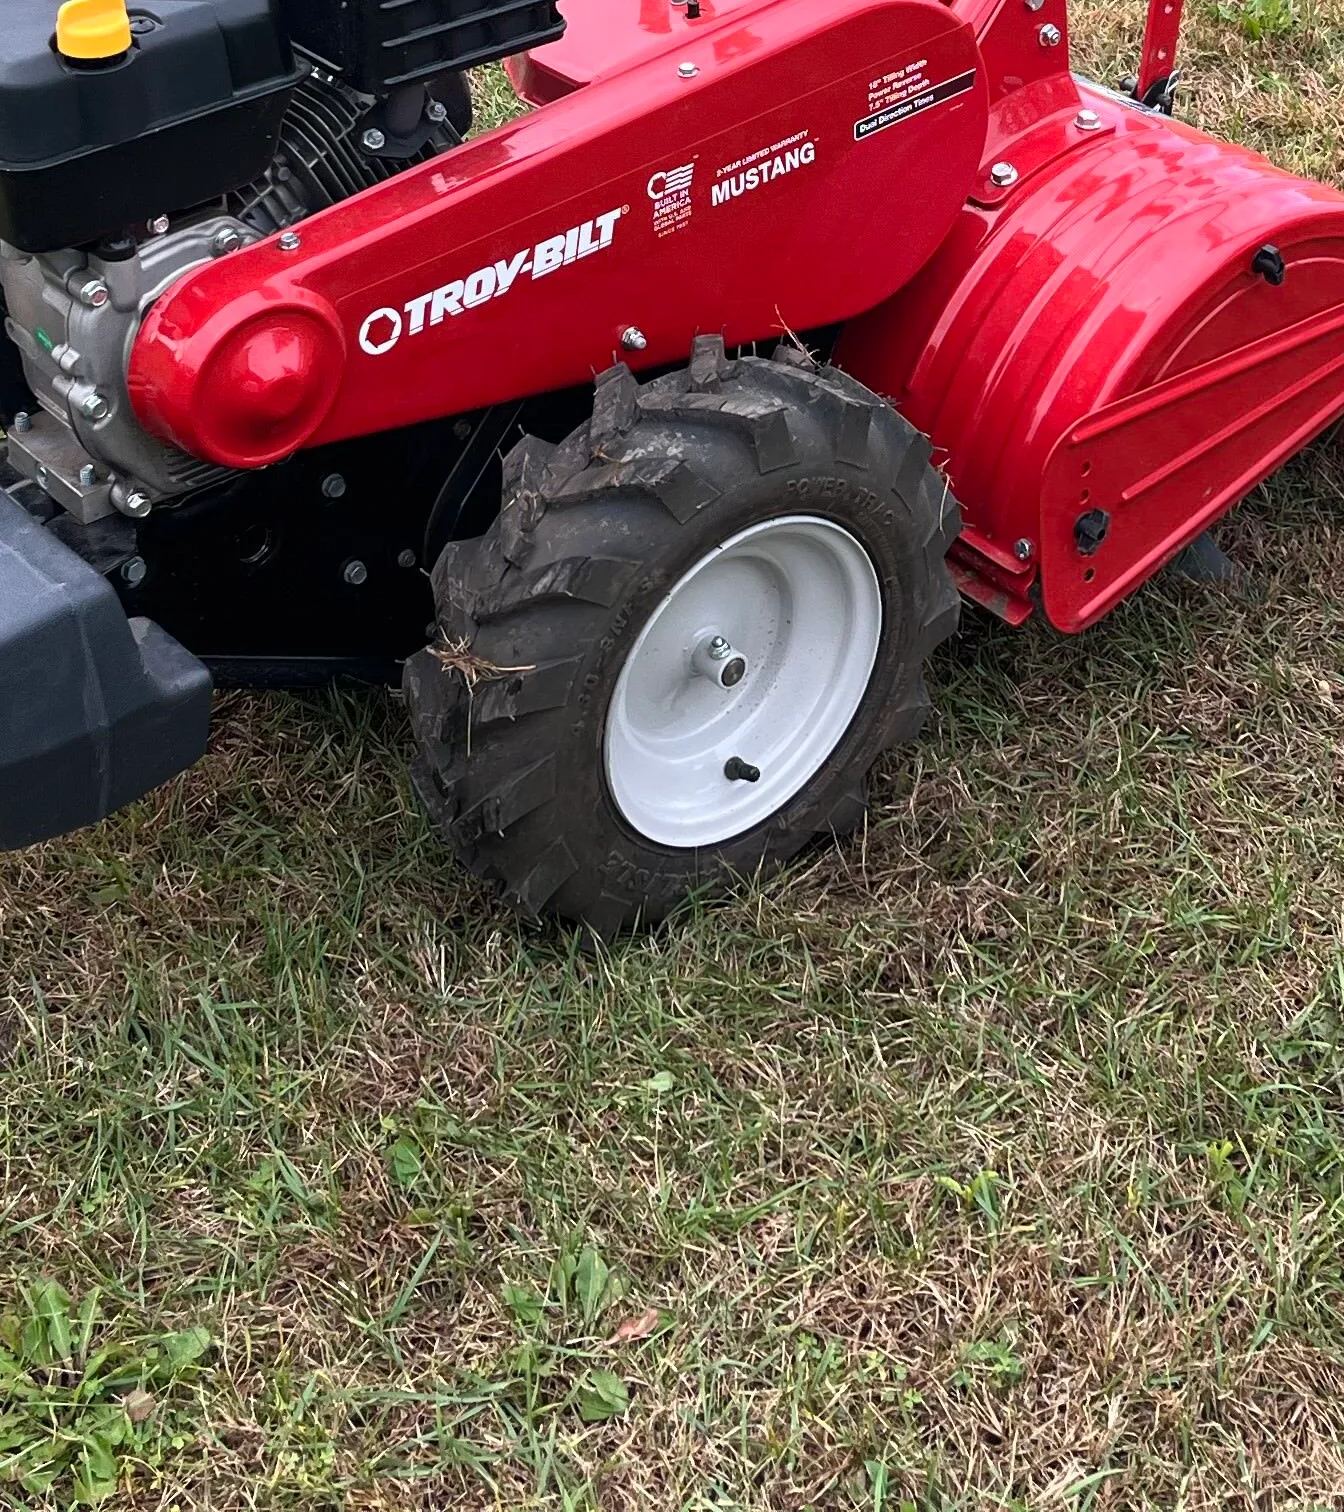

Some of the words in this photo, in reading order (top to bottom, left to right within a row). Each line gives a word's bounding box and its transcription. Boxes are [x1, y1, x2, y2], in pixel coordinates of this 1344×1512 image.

[868, 86, 892, 101] Power
[892, 72, 923, 91] Reverse
[907, 78, 931, 94] Depth
[859, 118, 878, 133] Dual
[878, 103, 913, 125] Direction
[913, 94, 935, 108] Tines
[742, 147, 770, 166] LIMITED
[769, 129, 809, 152] WARRANTY
[711, 141, 816, 207] MUSTANG
[653, 196, 692, 219] AMERICA
[654, 193, 678, 210] BUILT
[679, 188, 689, 199] IN
[404, 207, 622, 336] TROY-BILT
